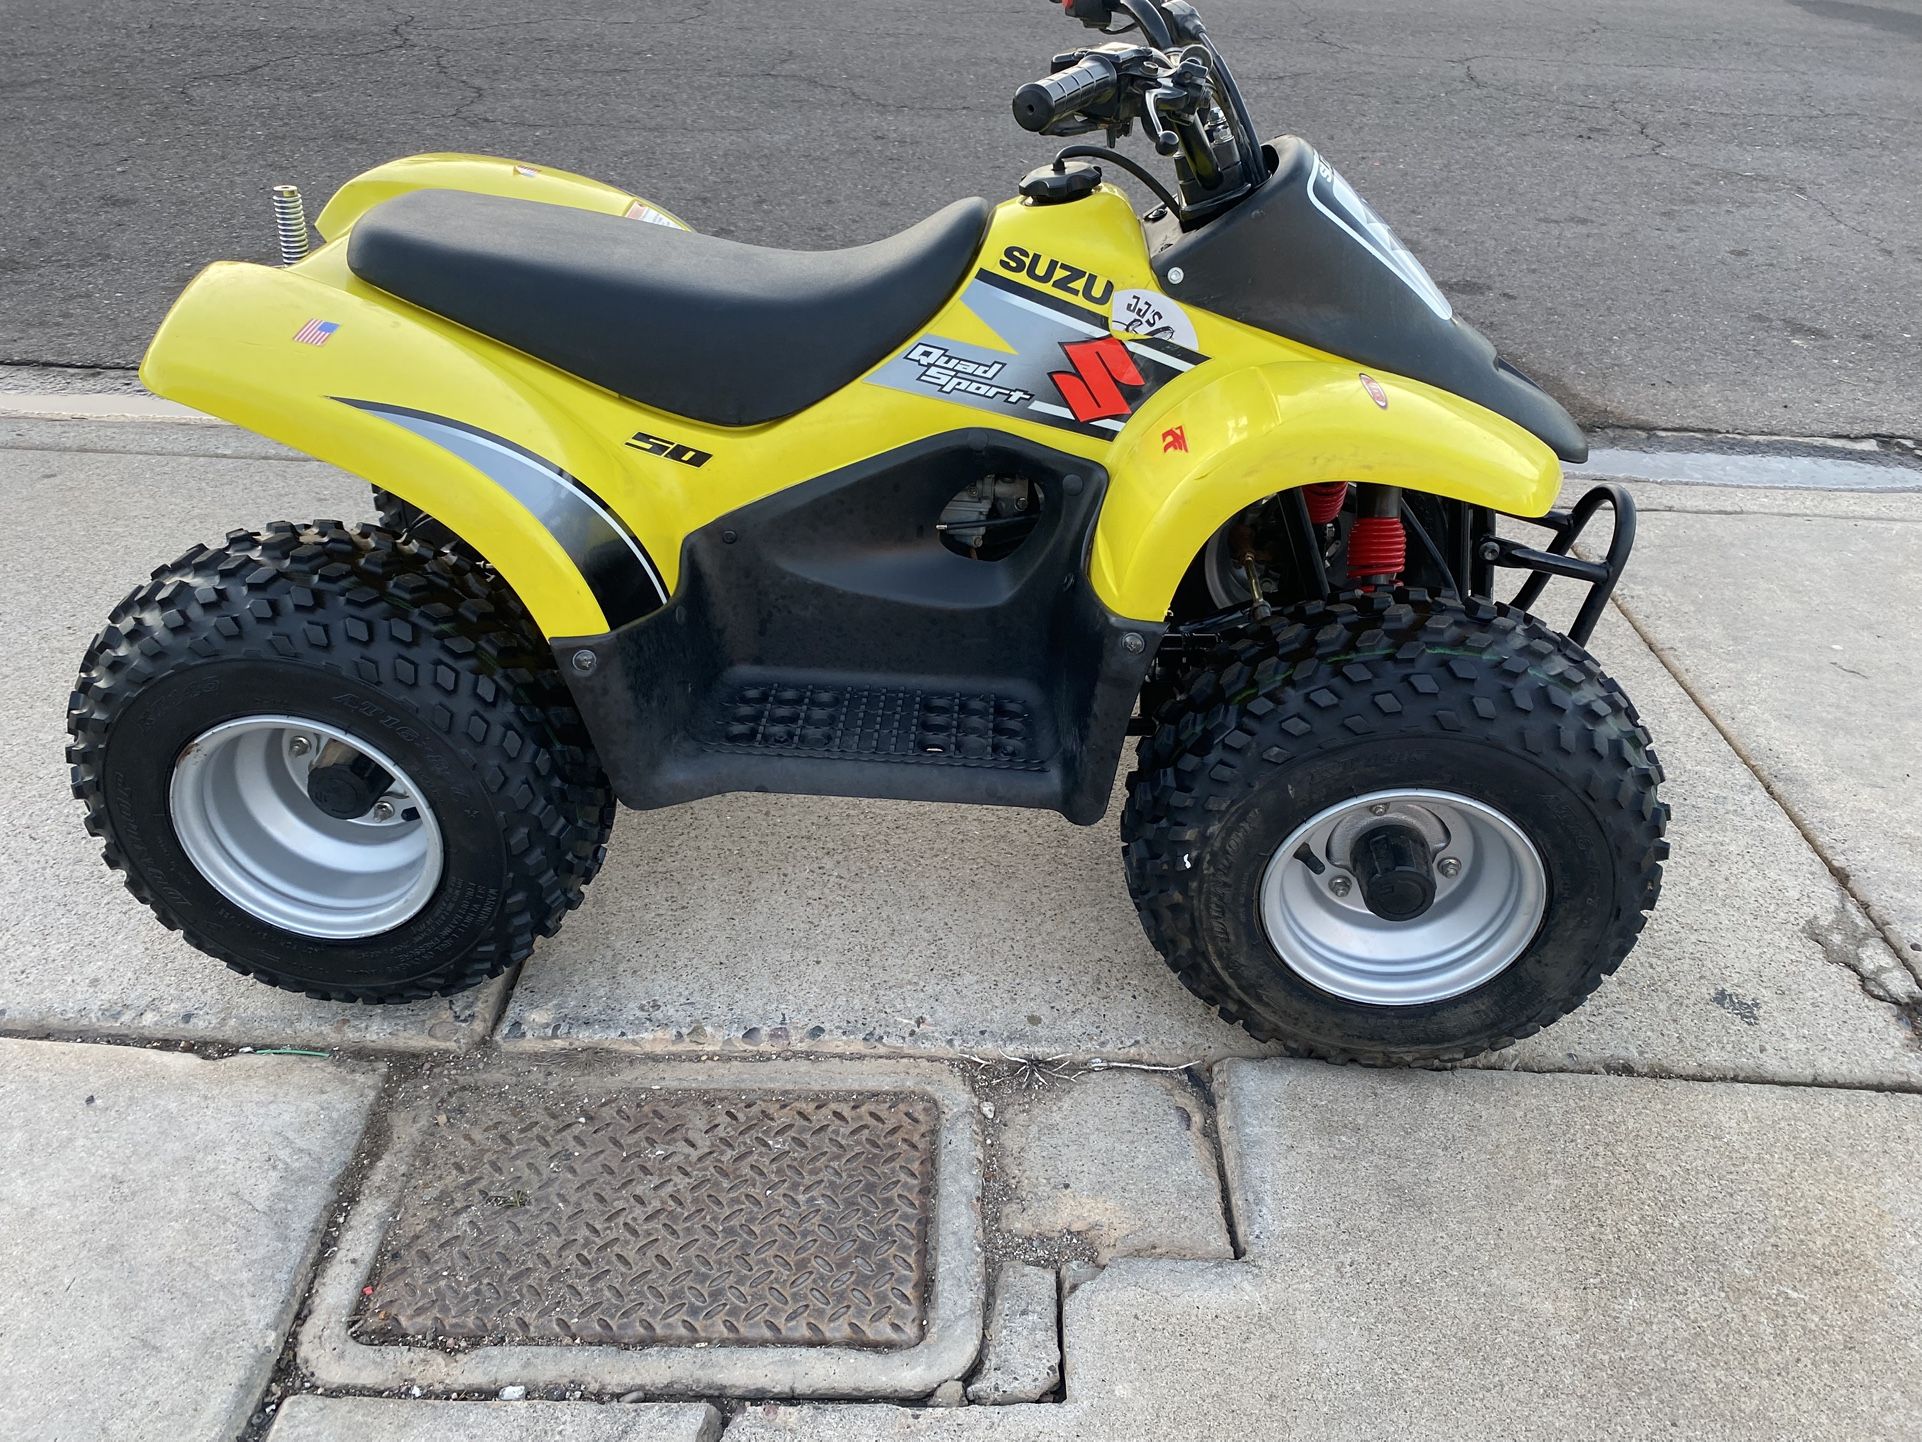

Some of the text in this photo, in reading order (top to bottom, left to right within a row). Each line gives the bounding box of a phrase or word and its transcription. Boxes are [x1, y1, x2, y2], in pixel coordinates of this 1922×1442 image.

[904, 342, 1007, 380] Quad
[916, 365, 1035, 404] Sport
[625, 432, 713, 468] 50
